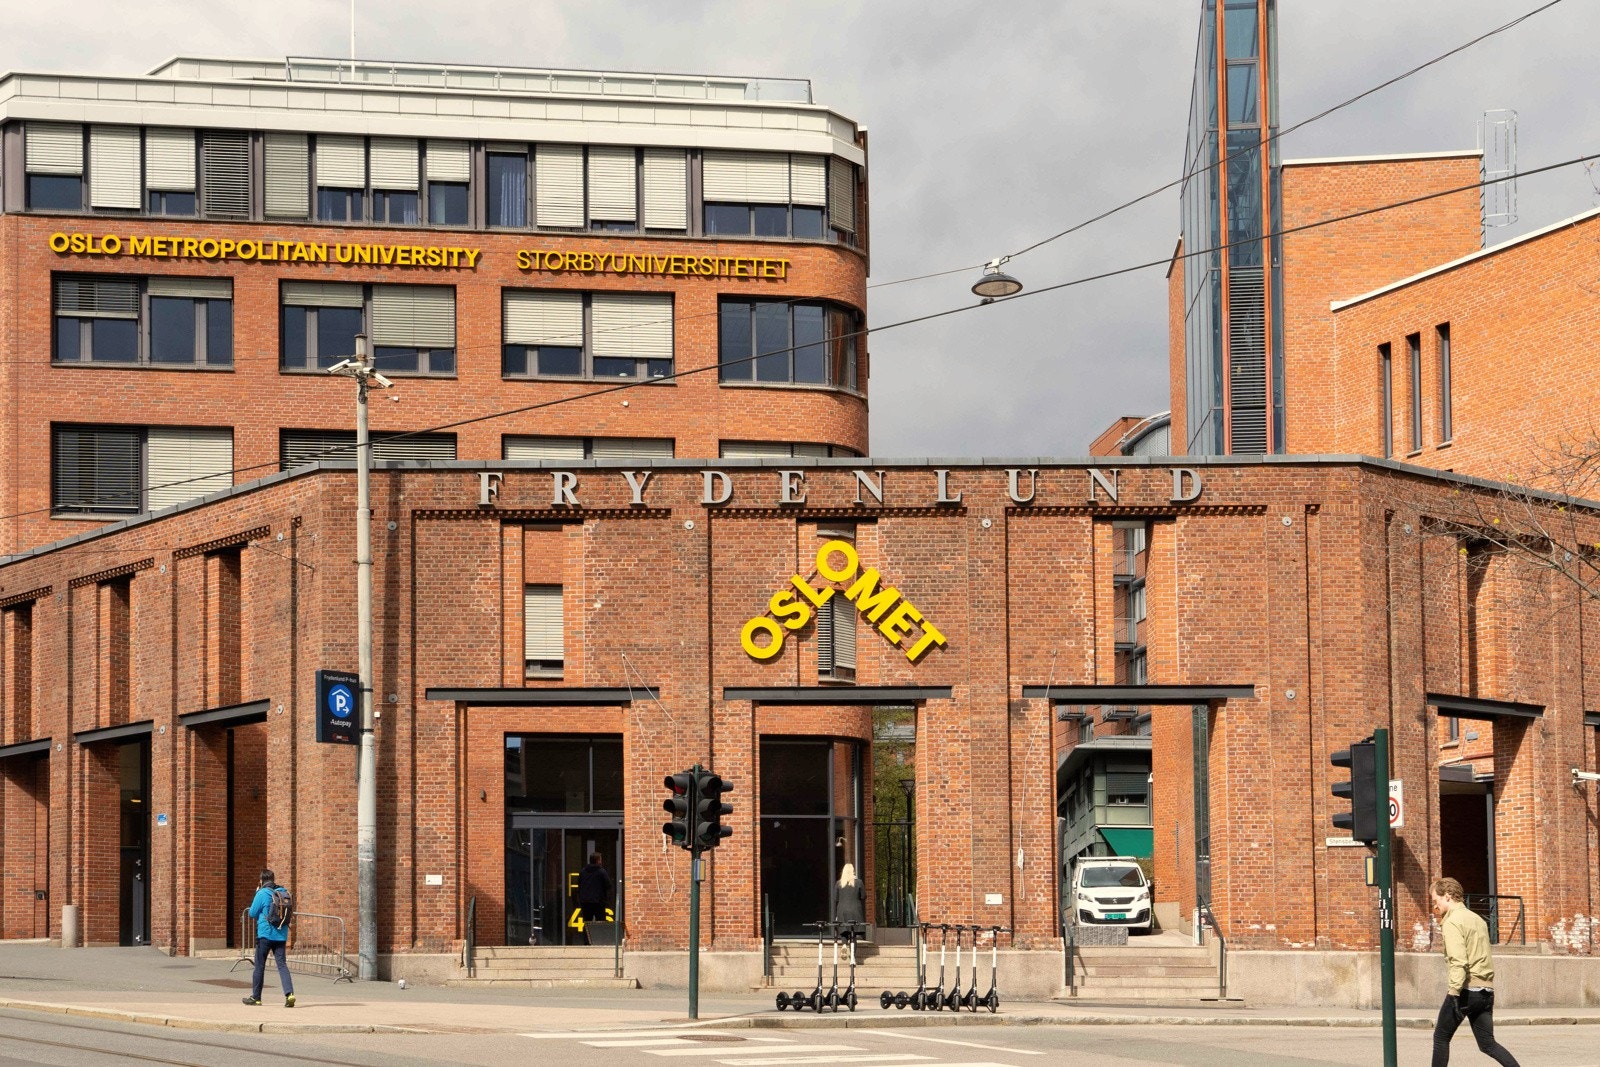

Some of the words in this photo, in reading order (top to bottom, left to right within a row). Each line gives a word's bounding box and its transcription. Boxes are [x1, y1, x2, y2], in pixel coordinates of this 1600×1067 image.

[48, 231, 122, 254] OSLO
[129, 234, 328, 263] METROPOLITAN
[335, 242, 481, 268] UNIVERSITY
[516, 249, 790, 279] STORBYUNIVERSITETET
[336, 695, 346, 711] P
[330, 719, 352, 727] Autopay
[1389, 804, 1396, 817] 0
